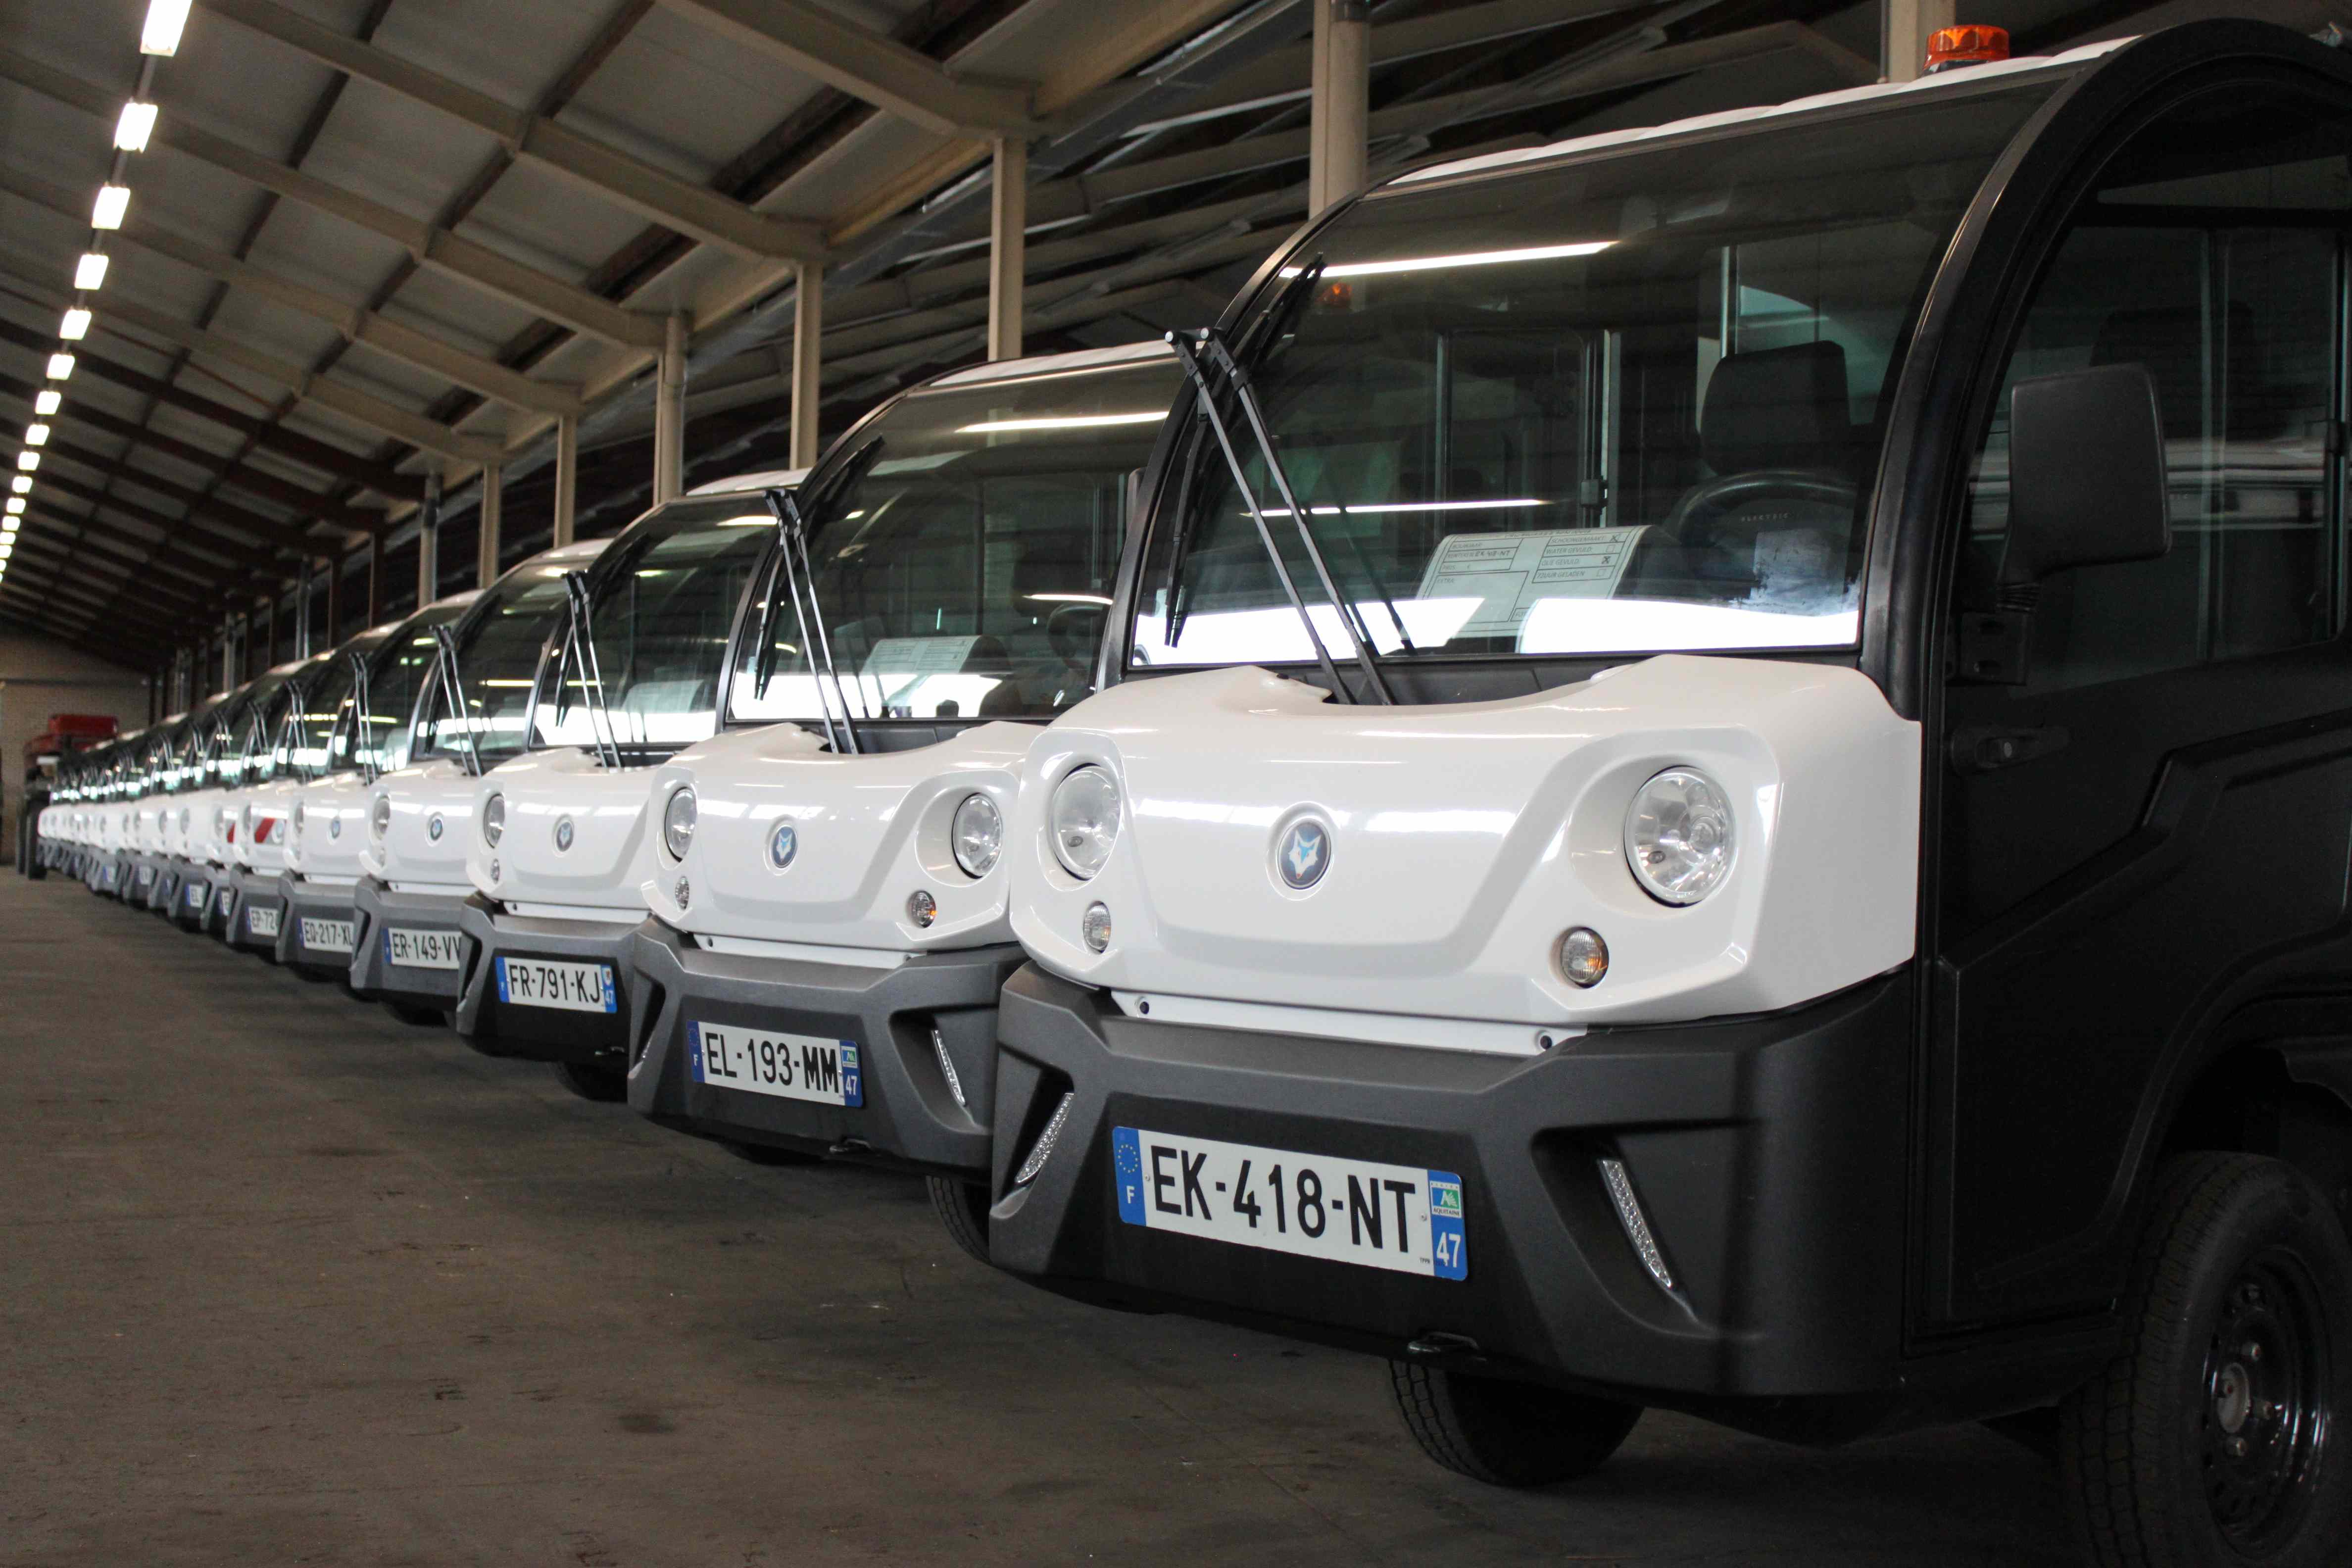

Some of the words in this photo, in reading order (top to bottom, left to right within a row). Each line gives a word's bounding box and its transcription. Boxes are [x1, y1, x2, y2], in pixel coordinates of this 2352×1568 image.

[509, 965, 600, 1003] FR-791-KJ
[705, 1032, 839, 1093] EL-193-MM
[846, 1075, 857, 1095] 47
[1127, 1186, 1134, 1204] F
[1151, 1145, 1416, 1253] EK-418-NT
[1437, 1231, 1461, 1268] 47
